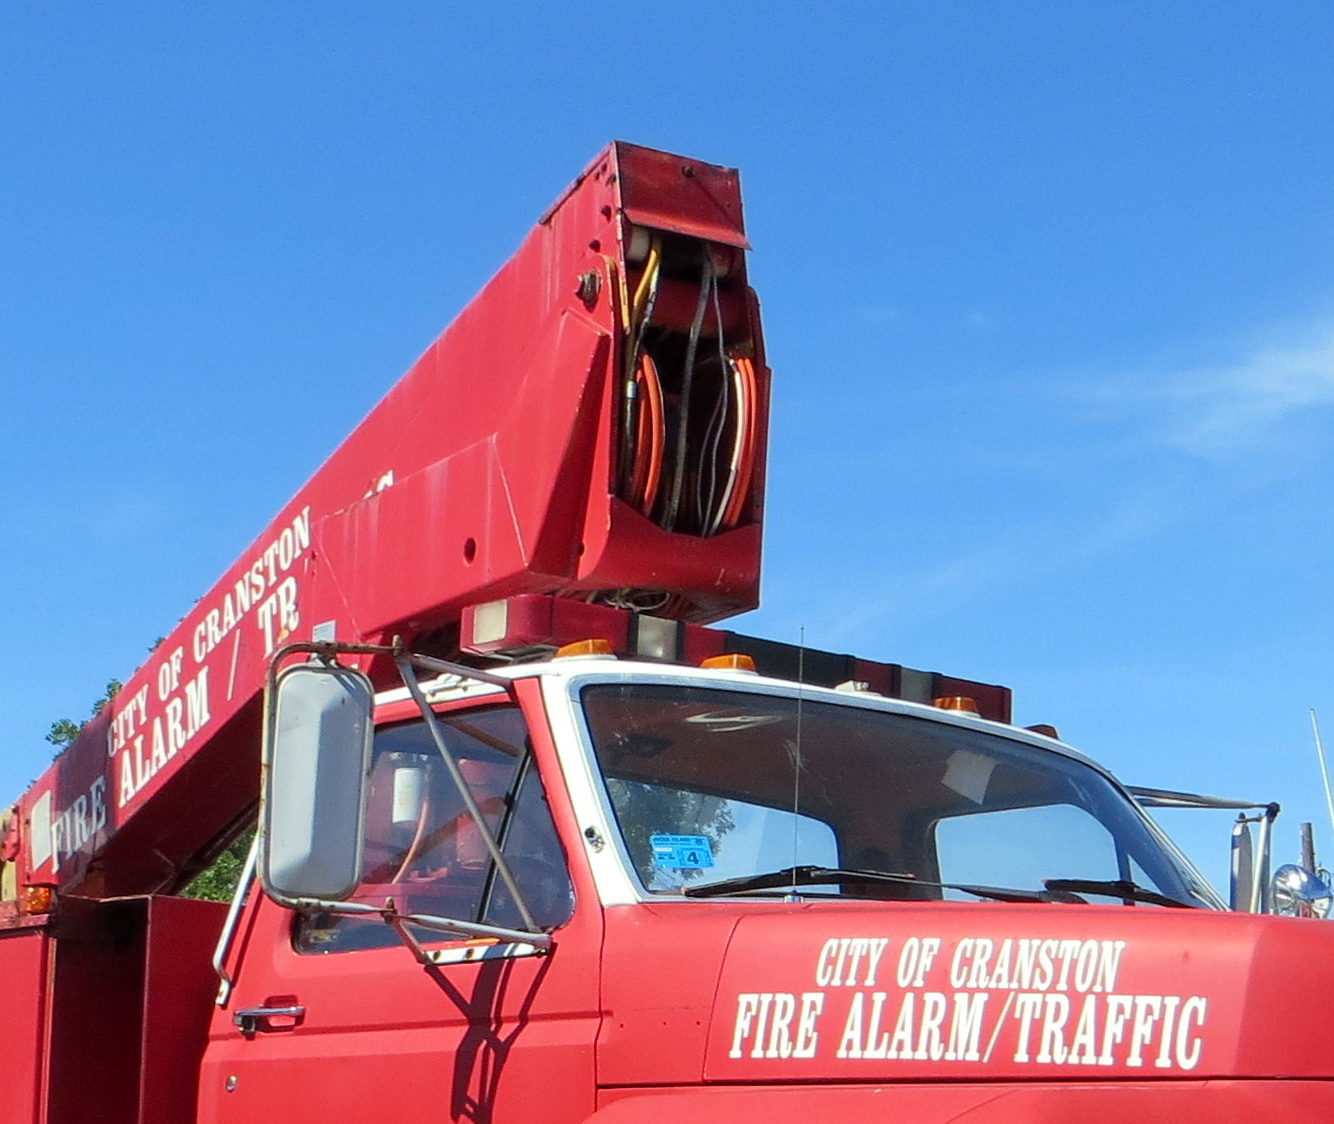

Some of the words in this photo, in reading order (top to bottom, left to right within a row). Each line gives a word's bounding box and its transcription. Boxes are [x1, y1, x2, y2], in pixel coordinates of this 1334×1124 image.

[107, 683, 148, 758] CITY
[158, 646, 185, 699] OF
[192, 505, 311, 663] CRANSTON
[51, 774, 107, 876] FIRE
[118, 665, 211, 809] ALARM
[686, 851, 700, 865] 4
[816, 937, 889, 988] CITY
[896, 936, 940, 987] OF
[950, 937, 1125, 993] CRANSTON
[729, 992, 823, 1059] FIRE
